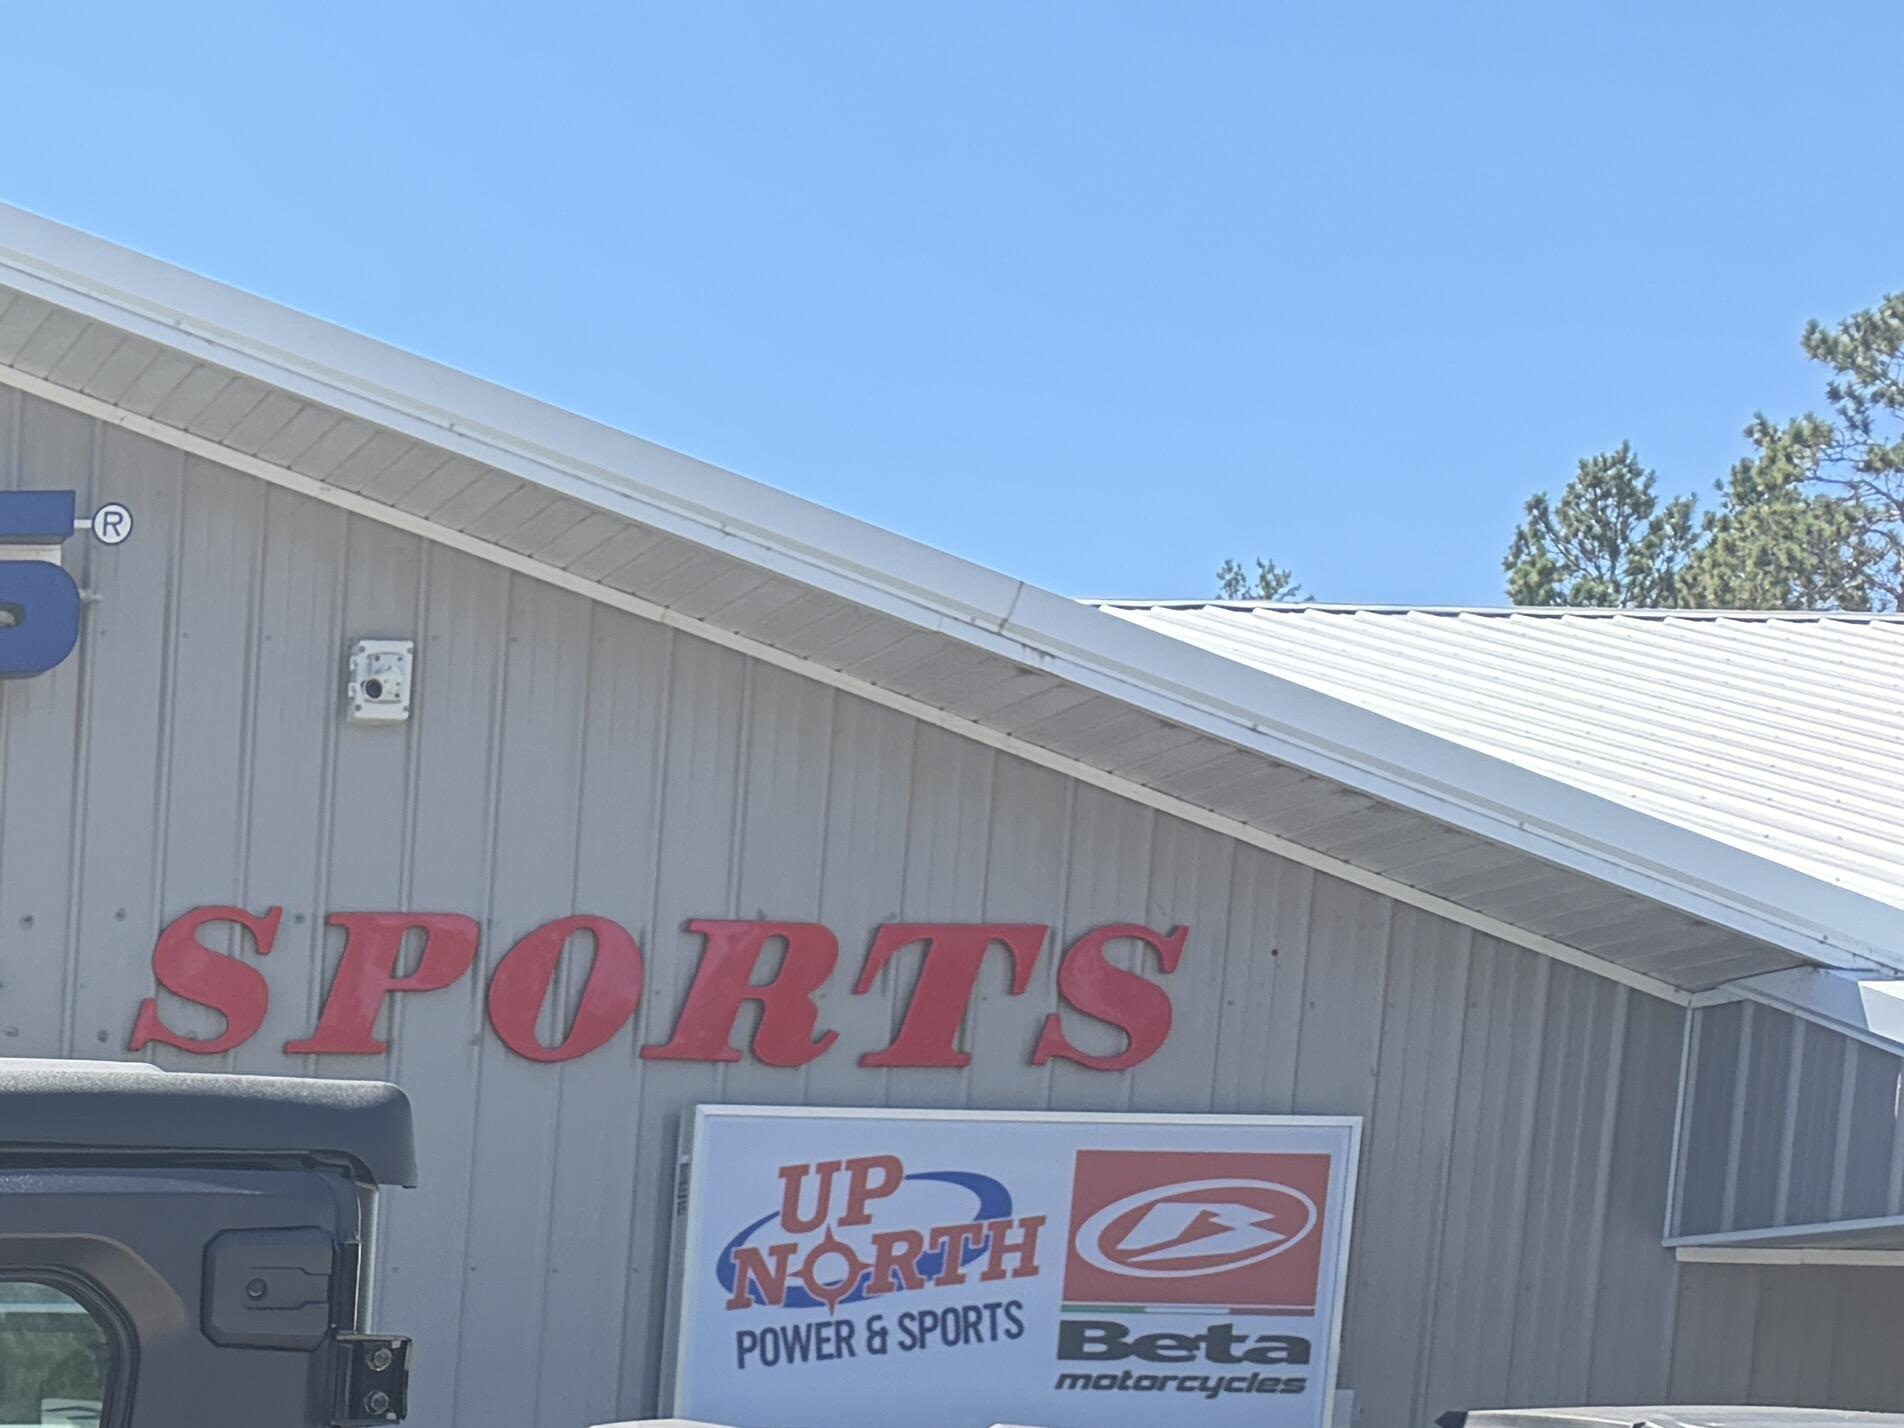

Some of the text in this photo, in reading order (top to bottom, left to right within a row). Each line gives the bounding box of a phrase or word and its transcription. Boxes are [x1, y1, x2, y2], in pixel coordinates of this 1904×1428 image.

[129, 906, 1189, 1071] SPORTS
[777, 1154, 905, 1235] UP
[725, 1214, 1047, 1317] NORTH
[736, 1299, 1025, 1370] POWER & SPORTS
[1055, 1319, 1311, 1366] Beta
[1054, 1371, 1307, 1400] motorcycles
